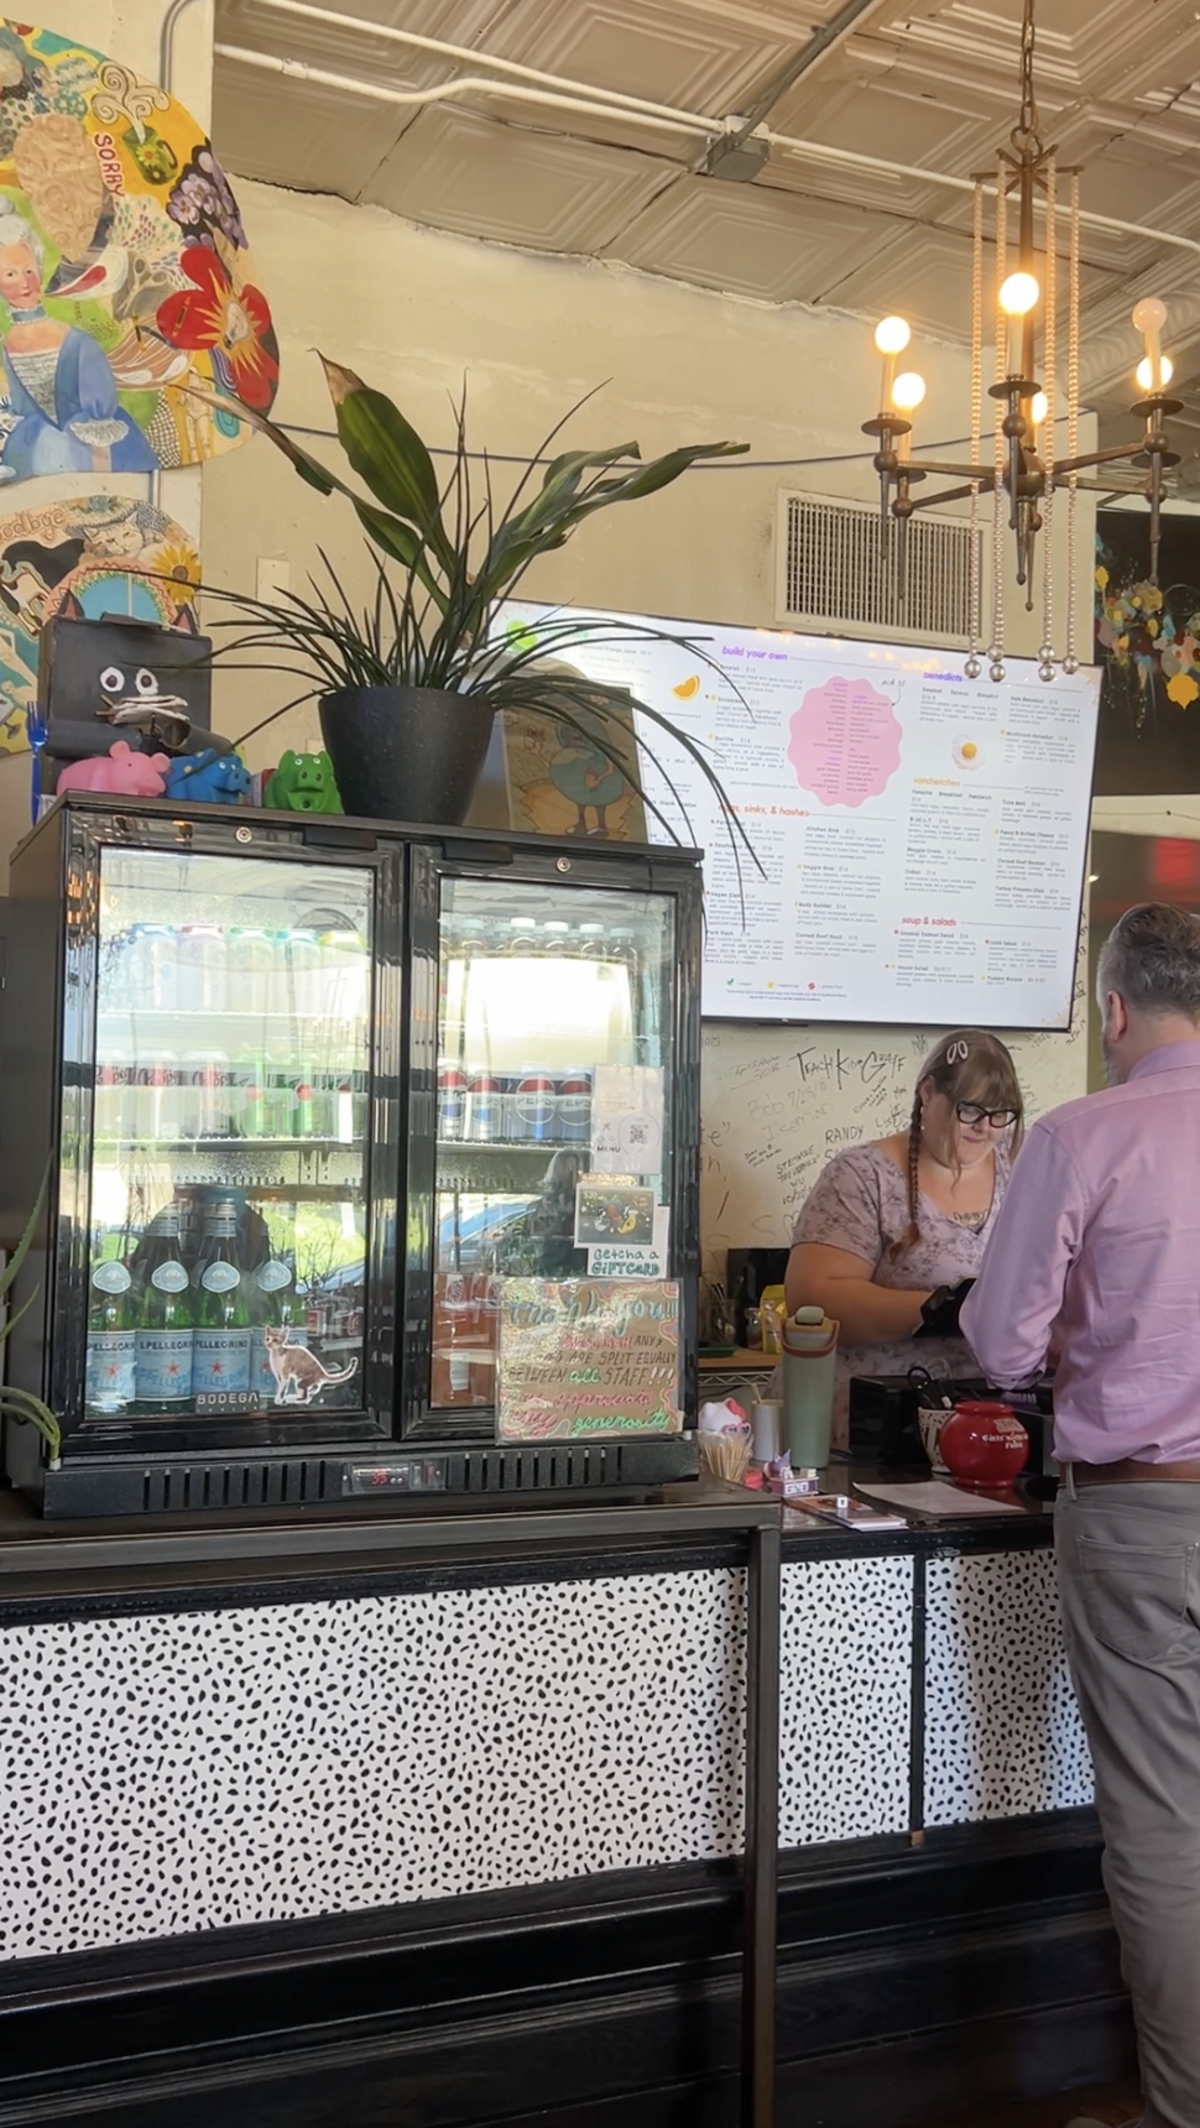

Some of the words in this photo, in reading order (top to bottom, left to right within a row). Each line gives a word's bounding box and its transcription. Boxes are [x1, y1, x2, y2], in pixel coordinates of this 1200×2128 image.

[94, 134, 125, 197] SORRY
[722, 645, 745, 656] build
[746, 648, 767, 659] your
[768, 652, 788, 660] own
[923, 672, 963, 683] benedicts
[913, 777, 961, 788] sandwiches
[744, 804, 768, 815] sinks,
[770, 806, 778, 815] &
[779, 807, 810, 817] hashes
[902, 917, 921, 927] soup
[923, 916, 930, 925] &
[931, 917, 957, 927] salads
[825, 1125, 864, 1144] RANDY
[649, 1251, 660, 1260] a
[570, 1352, 594, 1364] ARE
[600, 1351, 633, 1366] SPLIT
[635, 1351, 676, 1364] EQUALLY
[569, 1368, 601, 1383] all
[197, 1392, 259, 1404] BODEGA
[571, 1406, 670, 1437] generosity
